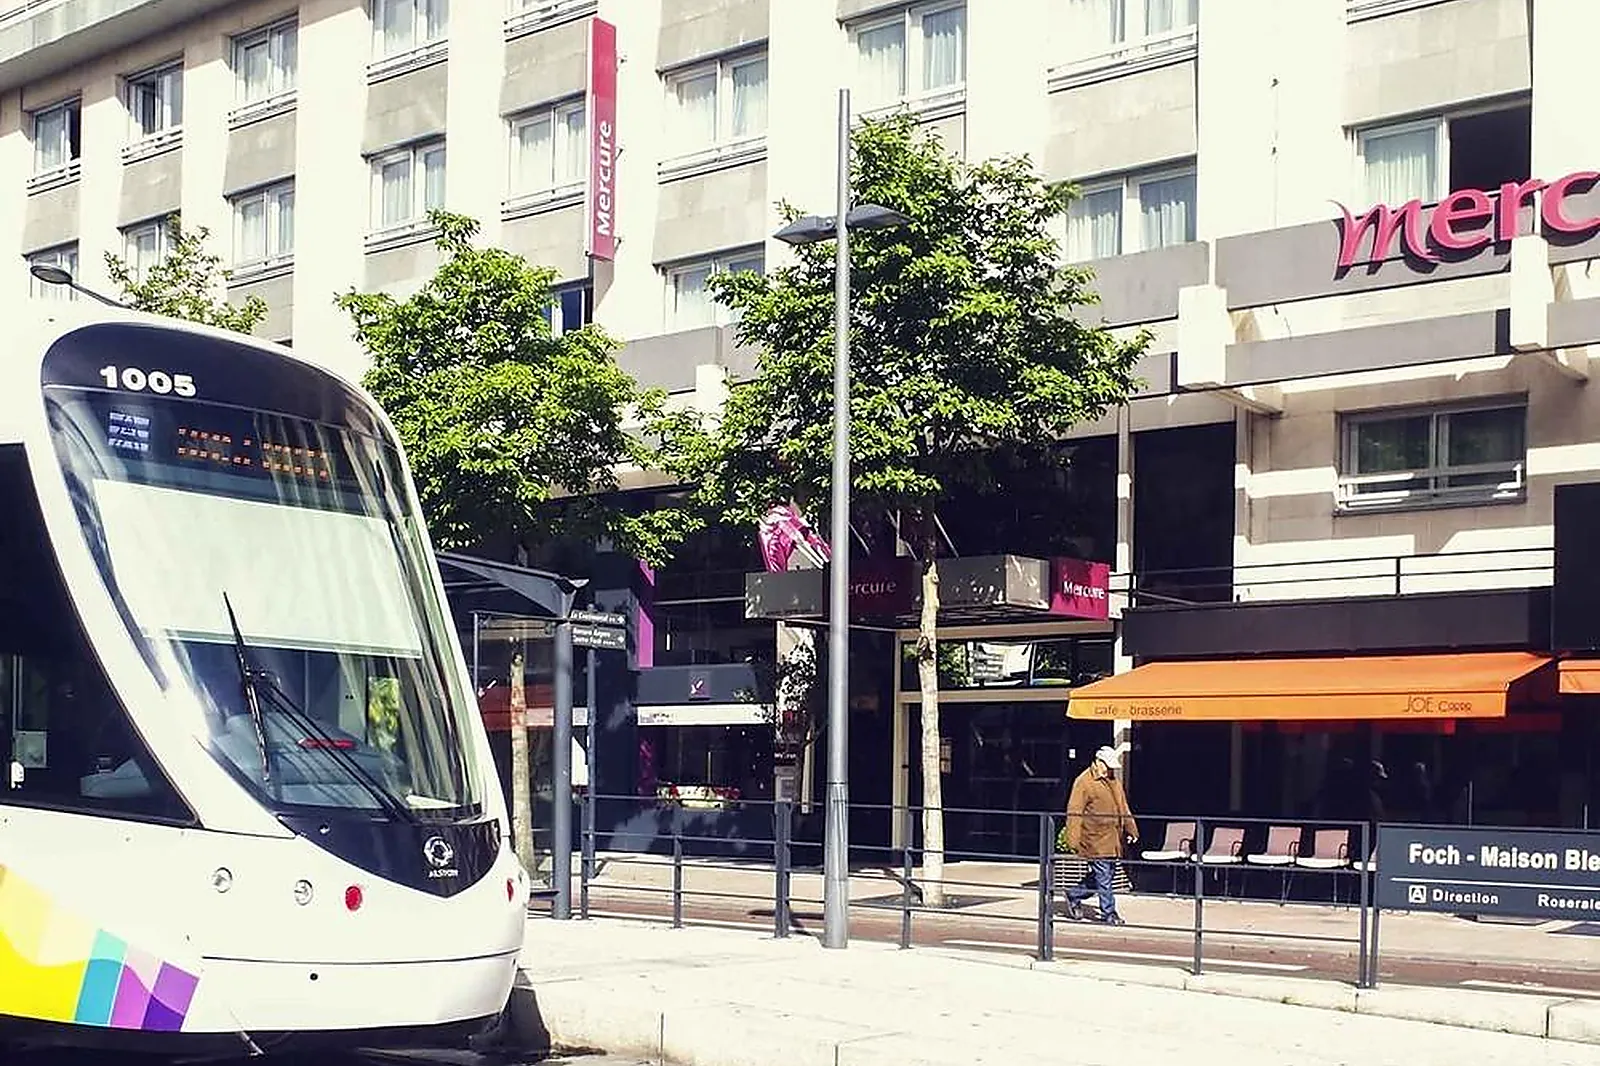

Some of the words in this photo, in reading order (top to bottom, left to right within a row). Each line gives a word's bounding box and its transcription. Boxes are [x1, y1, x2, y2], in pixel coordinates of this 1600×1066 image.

[597, 120, 612, 236] Mercure
[1329, 171, 1600, 266] merc
[99, 365, 197, 397] 1005
[1063, 581, 1105, 599] Mercure
[1402, 695, 1434, 713] JOE
[1409, 843, 1460, 866] Foch
[1481, 846, 1557, 869] Maison
[1433, 889, 1499, 905] Direction
